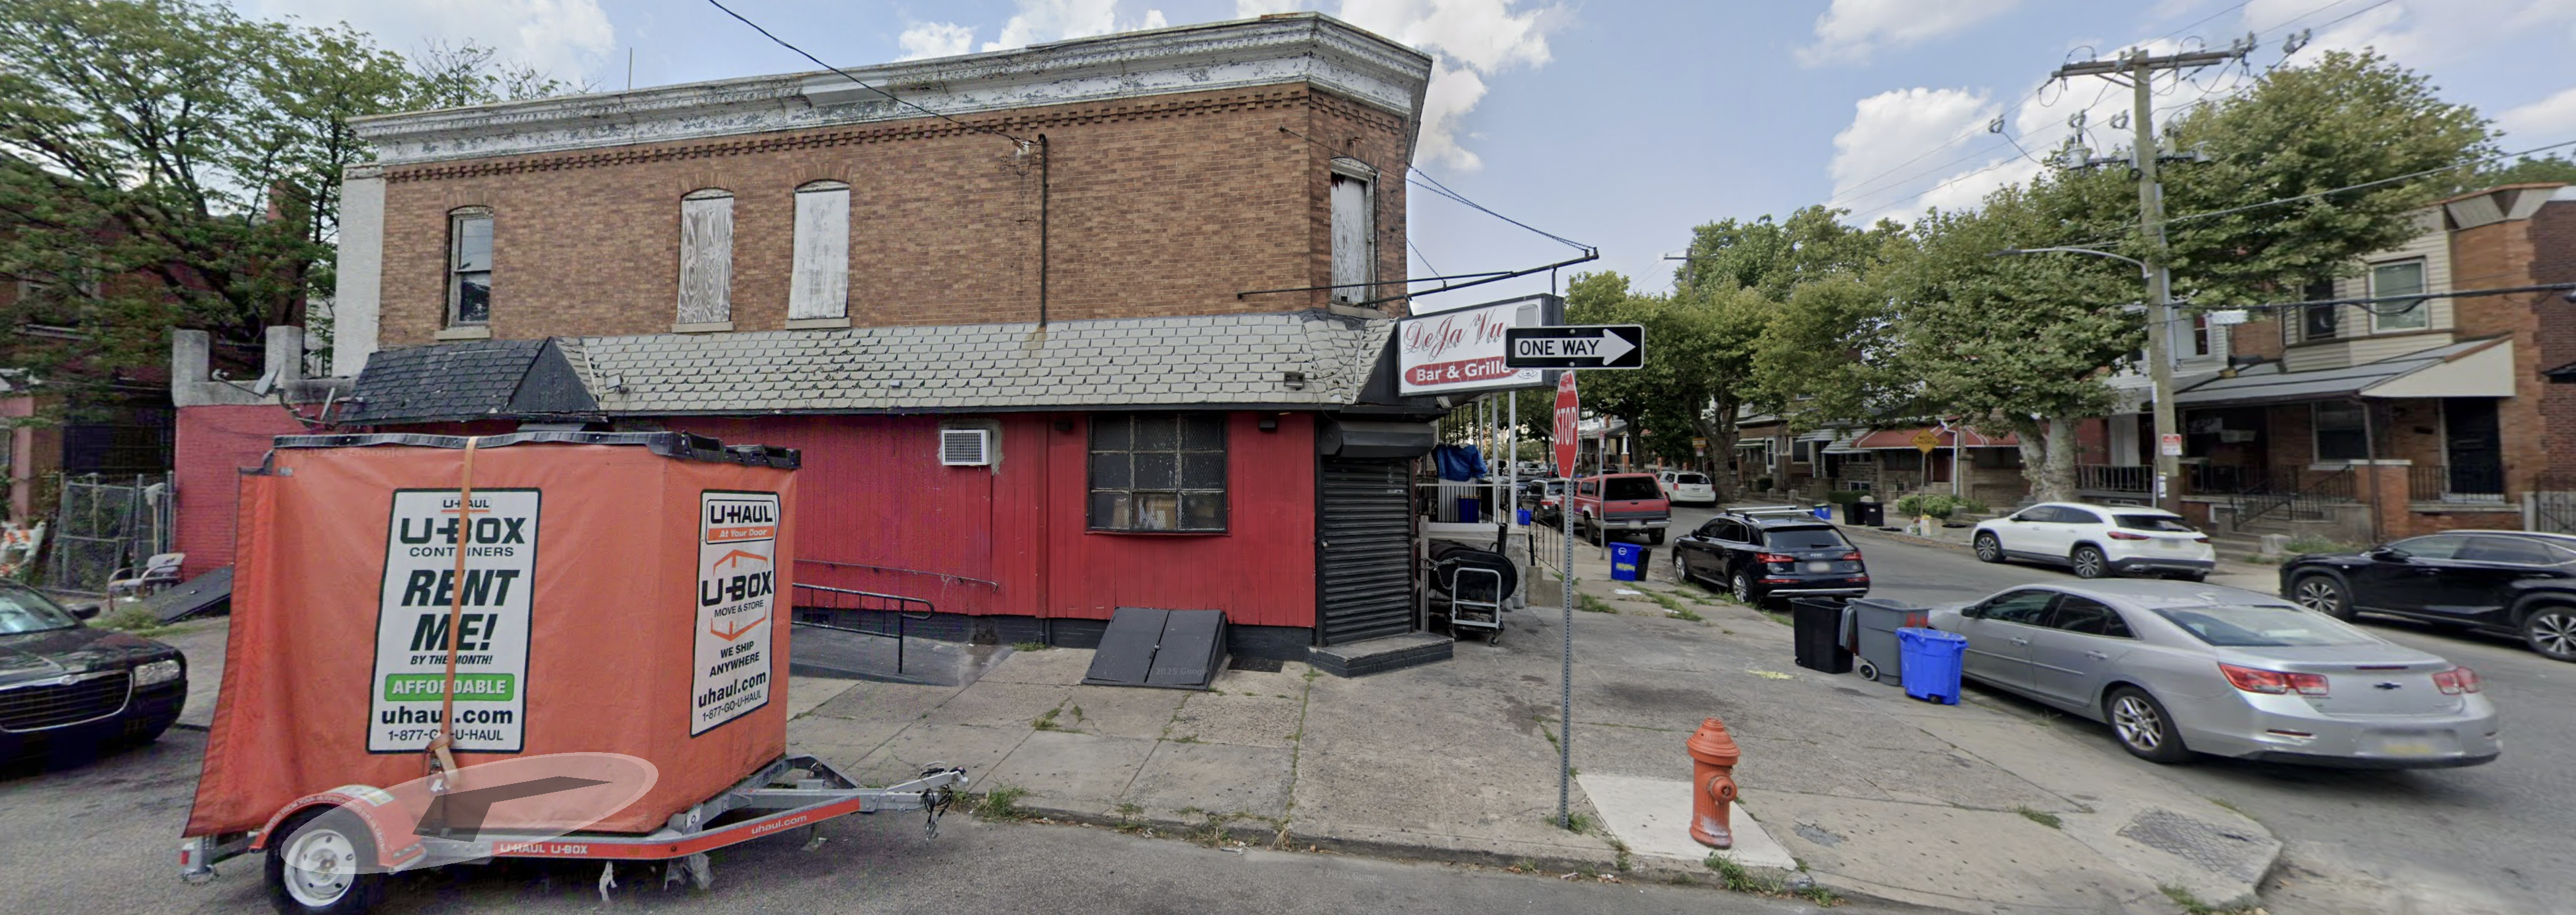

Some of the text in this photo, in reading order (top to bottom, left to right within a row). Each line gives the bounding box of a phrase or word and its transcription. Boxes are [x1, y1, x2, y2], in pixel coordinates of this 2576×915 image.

[1404, 309, 1507, 361] DeJa Vu
[1520, 340, 1600, 356] ONE WAY
[1416, 368, 1441, 381] Bar
[1447, 365, 1459, 379] &
[1555, 406, 1577, 446] STOP
[710, 505, 773, 524] U-HAUL
[400, 517, 527, 544] U-BOX
[409, 547, 514, 557] CONTINERS
[400, 569, 521, 606] RENT
[702, 570, 772, 607] U-BOX
[714, 605, 737, 618] MOVE
[743, 599, 764, 611] STORE
[409, 614, 498, 651] ME!
[720, 640, 755, 659] WE SHIP
[410, 655, 493, 665] BY THE MONTH!
[709, 651, 760, 677] ANYWHERE
[698, 671, 766, 708] uhaul.com
[381, 705, 513, 724] uhau.com
[702, 689, 762, 722] 1-877-GO-U-HAUL
[388, 729, 504, 741] 1-877-G-U-HAUL
[751, 814, 807, 835] uhaul.com
[500, 843, 588, 854] U-HAUL U-BOX
